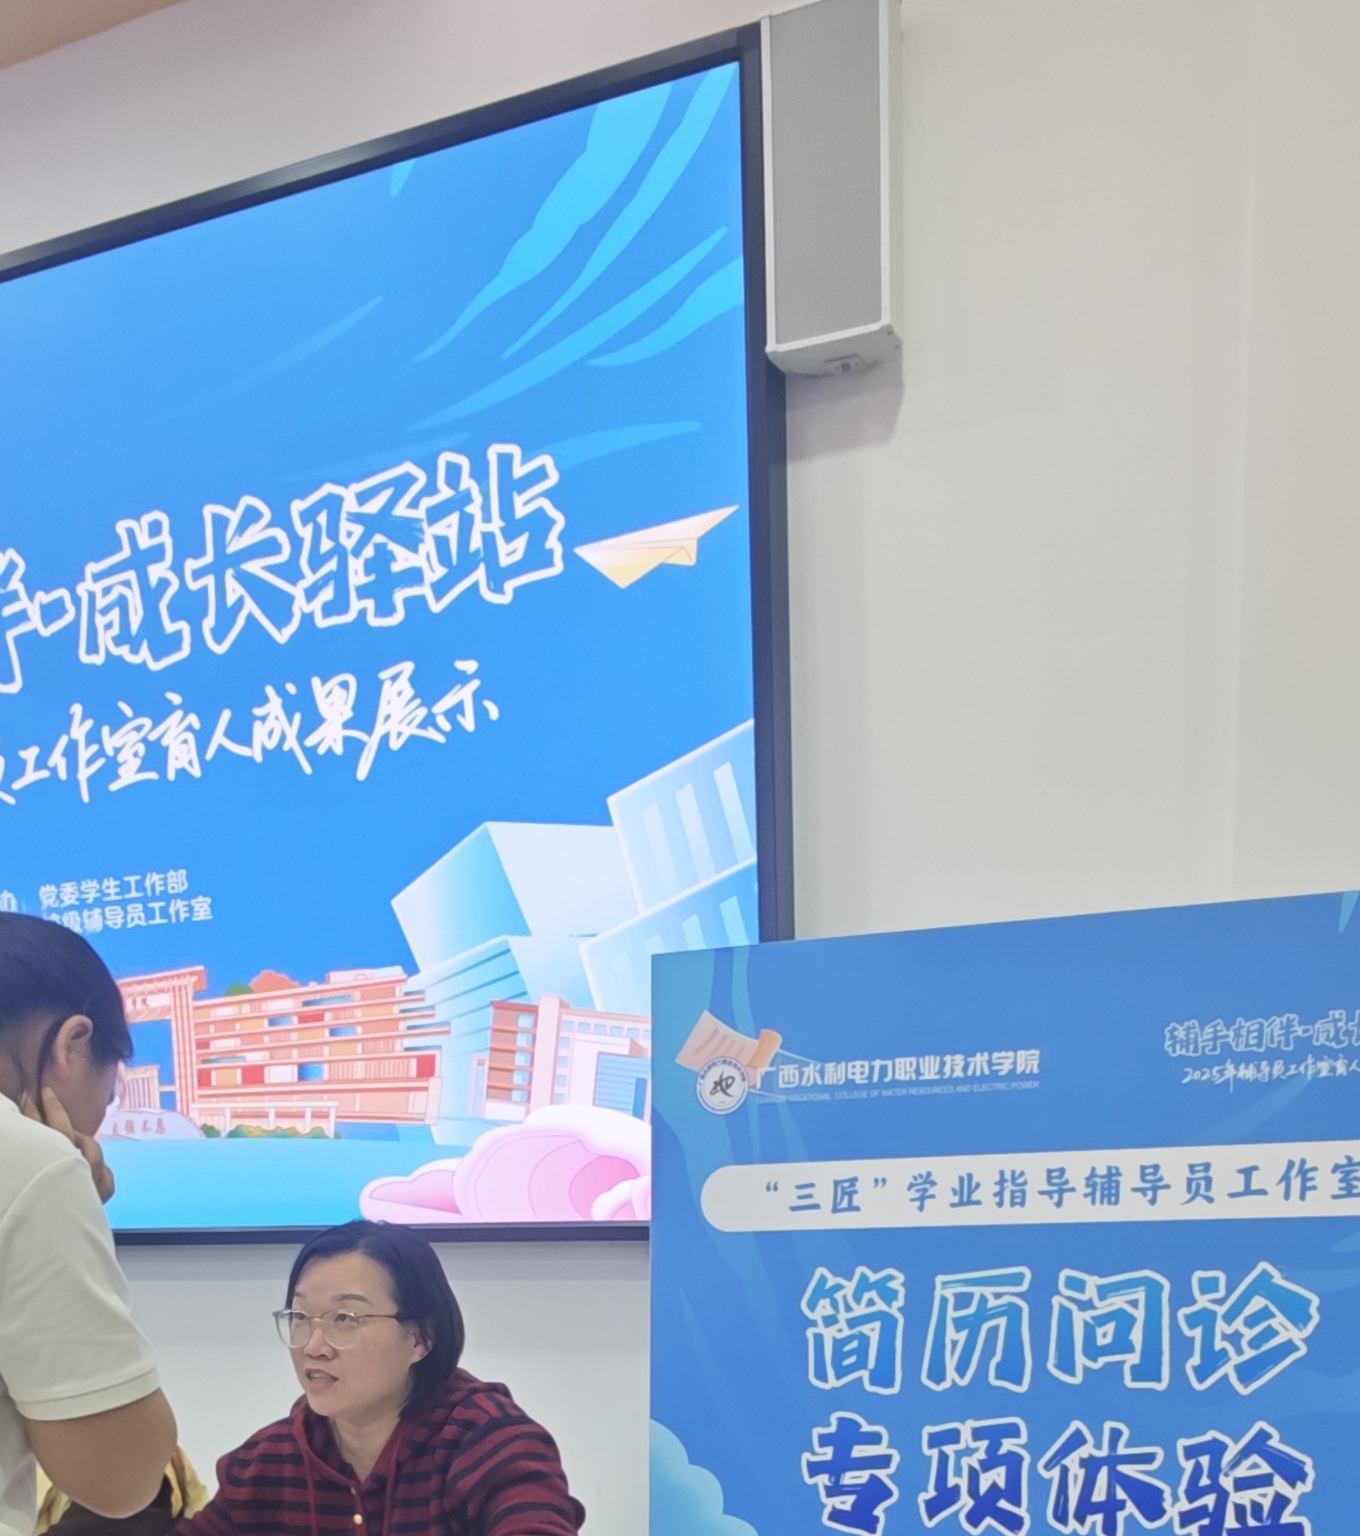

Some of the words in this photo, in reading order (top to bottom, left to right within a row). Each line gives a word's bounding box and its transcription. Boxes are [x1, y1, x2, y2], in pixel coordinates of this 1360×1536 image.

[39, 868, 189, 911] 党委学生工作部
[755, 1049, 1040, 1090] 广西水利电力职业技术学院
[802, 1261, 1319, 1395] 简历问诊
